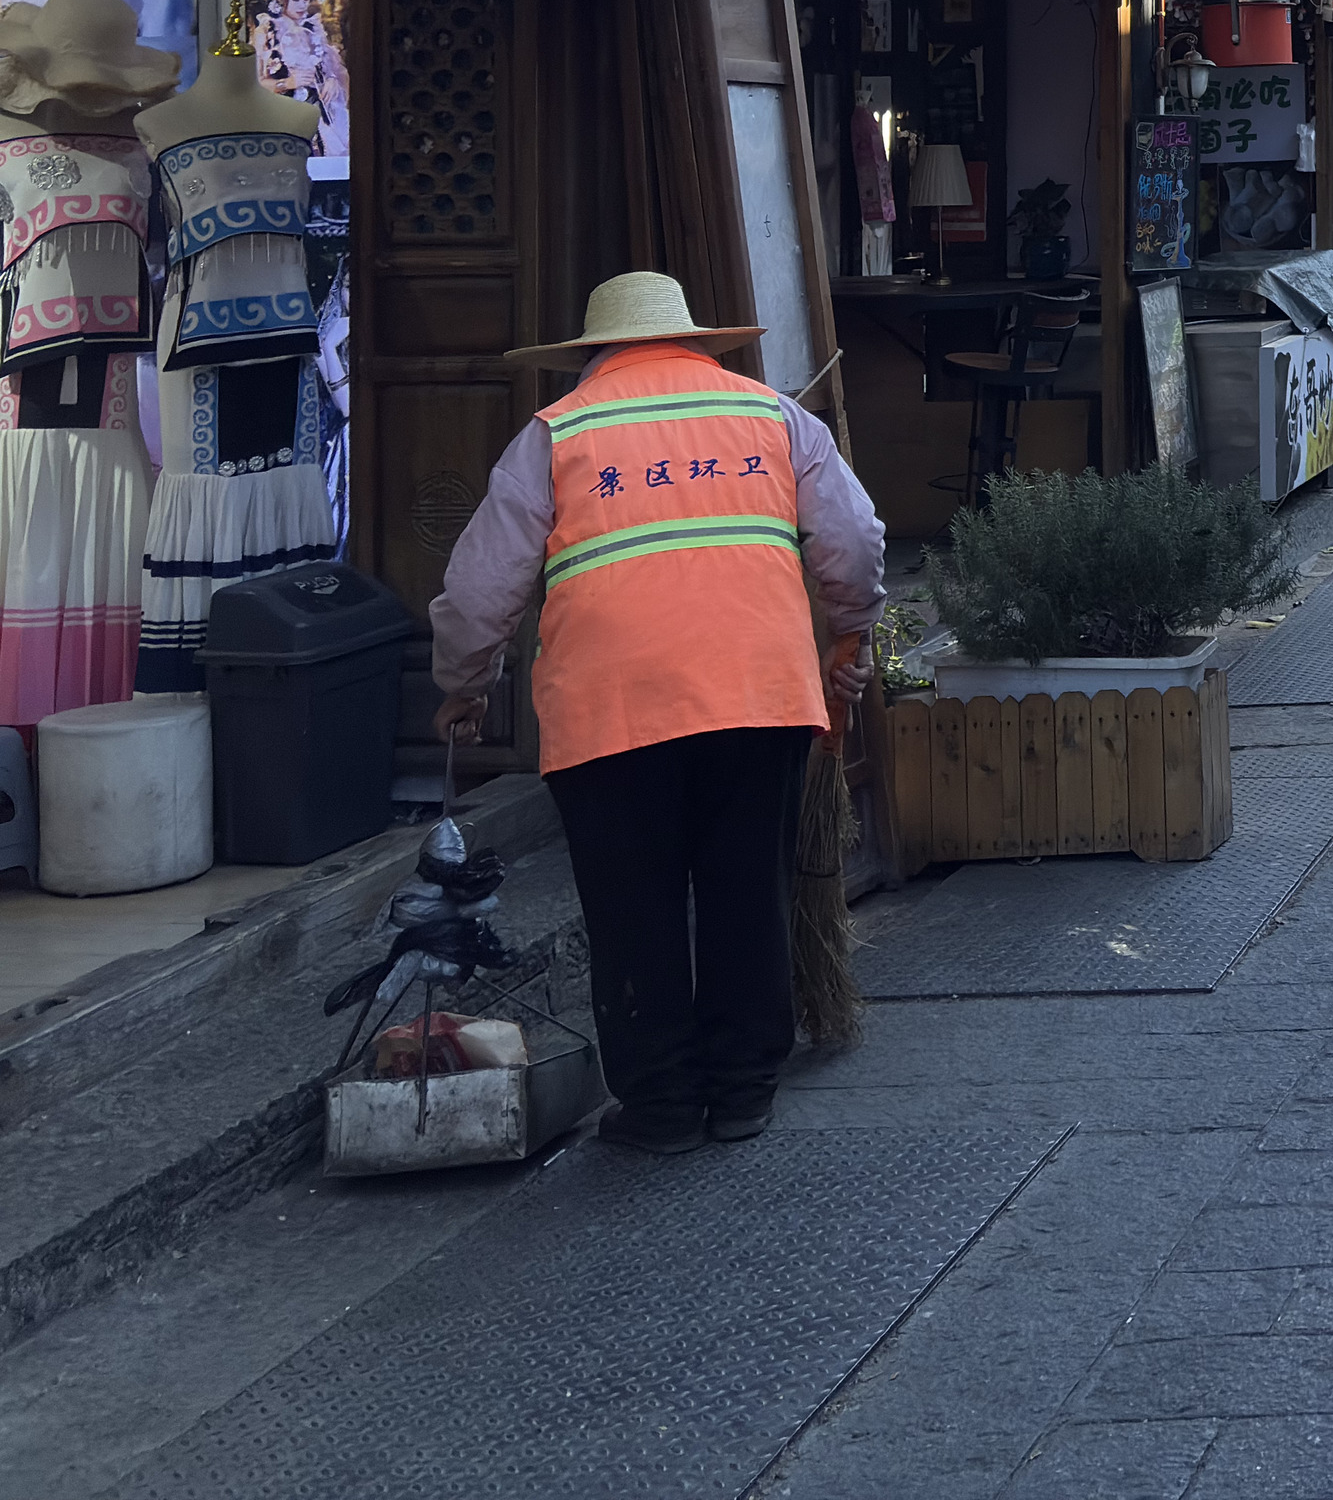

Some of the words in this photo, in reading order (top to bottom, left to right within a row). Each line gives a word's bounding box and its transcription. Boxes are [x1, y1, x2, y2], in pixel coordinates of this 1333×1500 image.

[1199, 117, 1258, 155] 菌子
[588, 455, 770, 499] 景区环卫
